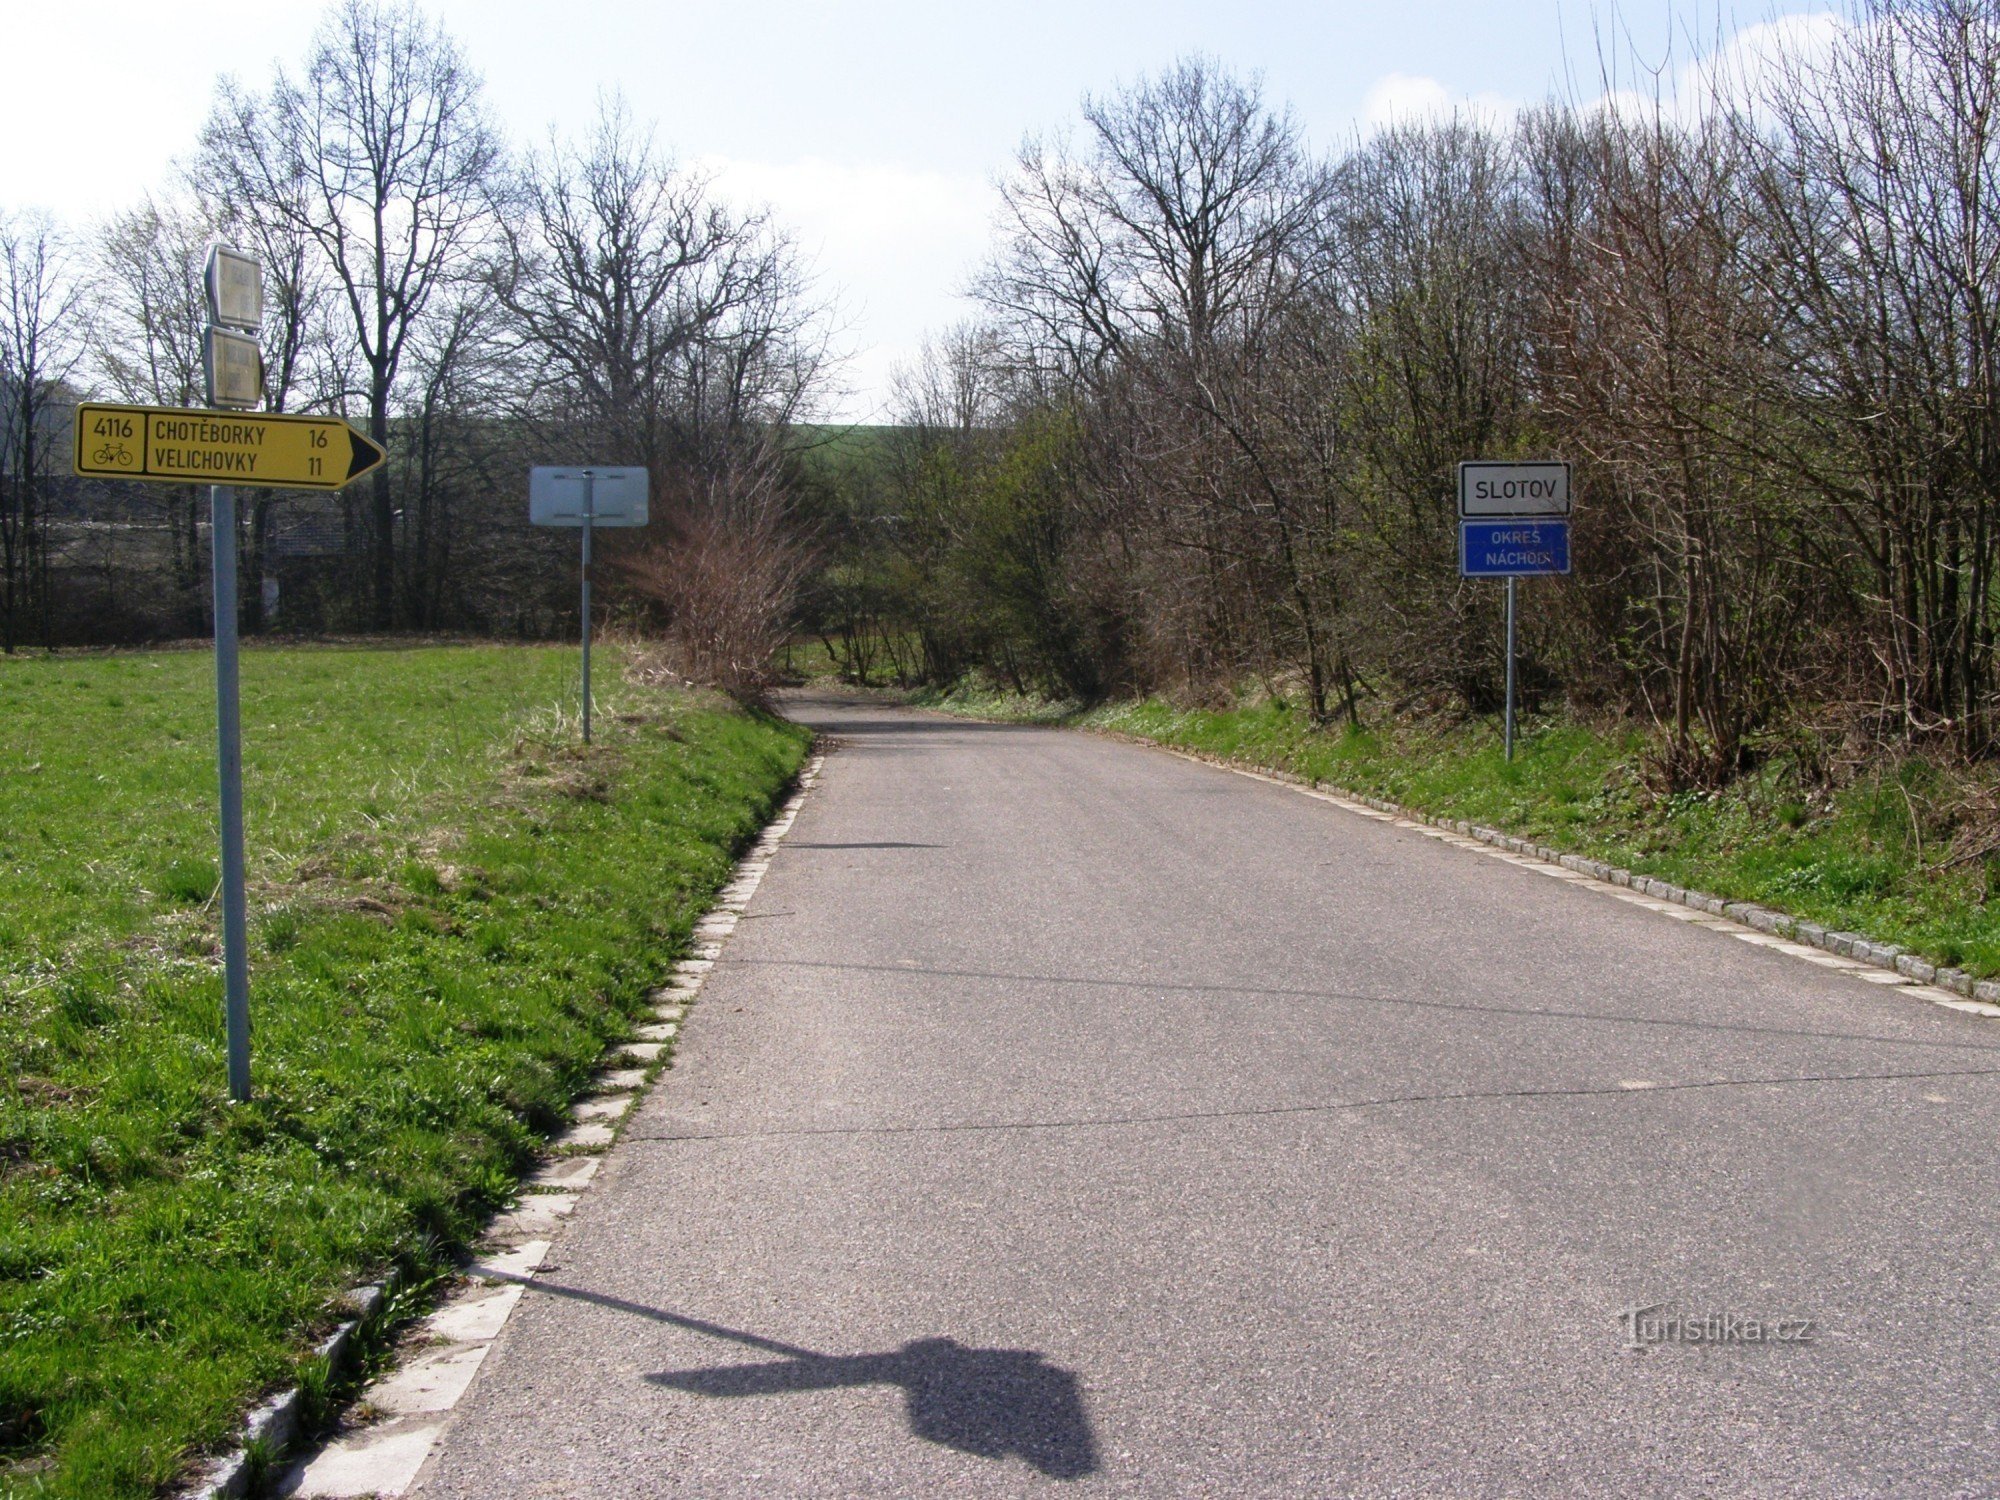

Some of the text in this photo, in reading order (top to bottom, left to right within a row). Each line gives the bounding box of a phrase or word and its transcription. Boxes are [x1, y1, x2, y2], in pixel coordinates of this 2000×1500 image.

[94, 418, 133, 438] 4116
[156, 417, 328, 449] CHOTĚBORKY 16
[155, 448, 322, 476] VELICHOVKY 11
[1475, 480, 1556, 499] SLOTOV
[1491, 531, 1541, 544] OKRES
[1486, 549, 1547, 565] NÁCHOD
